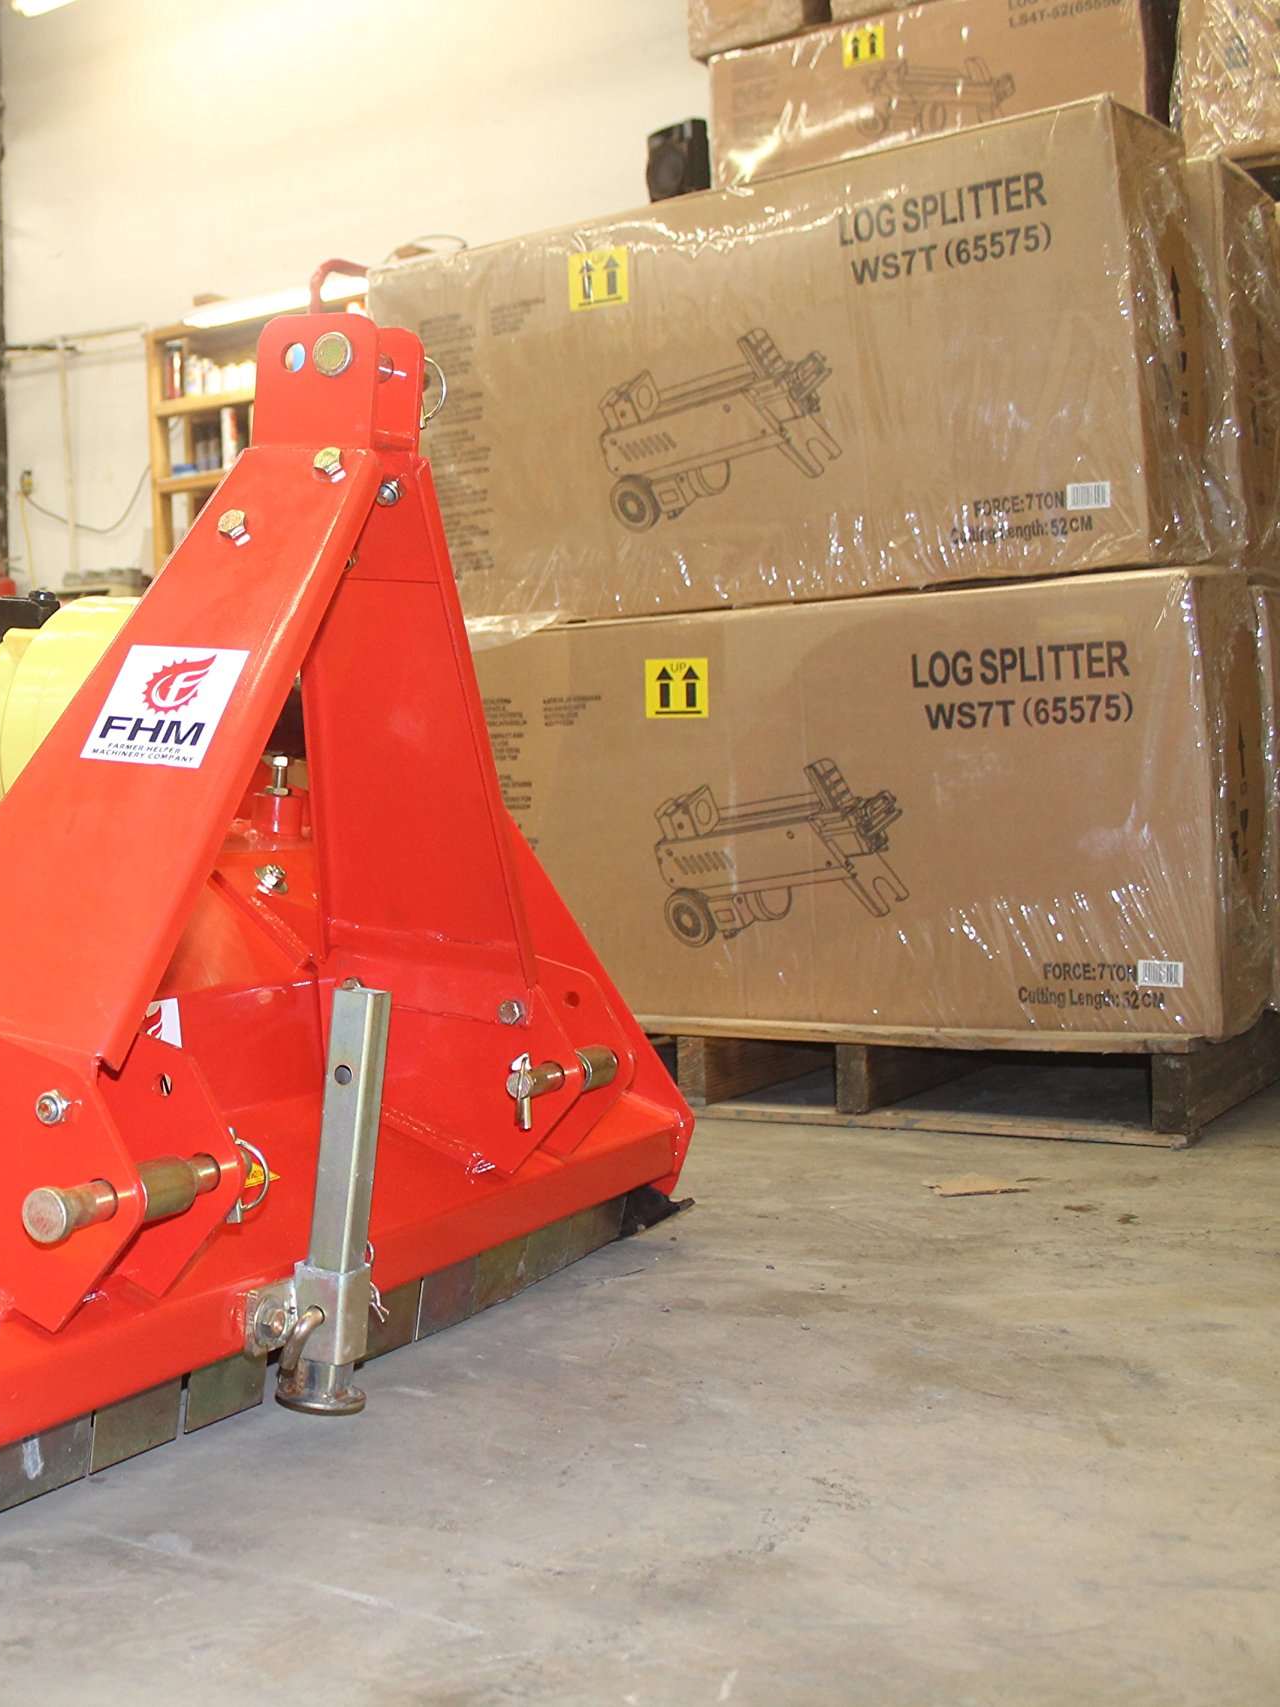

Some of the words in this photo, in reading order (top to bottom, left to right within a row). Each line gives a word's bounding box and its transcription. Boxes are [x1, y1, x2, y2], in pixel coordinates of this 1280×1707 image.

[838, 203, 896, 247] LOG
[902, 171, 1048, 233] SPLITTER
[851, 244, 938, 285] WS7T
[944, 221, 1052, 269] (65575)
[670, 662, 687, 673] UP
[911, 650, 973, 689] LOG
[979, 640, 1130, 685] SPLITTER
[924, 699, 1016, 731] WS7T
[1022, 691, 1134, 727] (65575)
[99, 715, 206, 746] FHM
[91, 748, 145, 758] MACHINERY
[147, 752, 195, 763] COMPANY
[107, 742, 144, 751] FARMER
[146, 745, 182, 754] HELPER
[1018, 987, 1066, 1008] Cutting
[1070, 988, 1119, 1010] Length:
